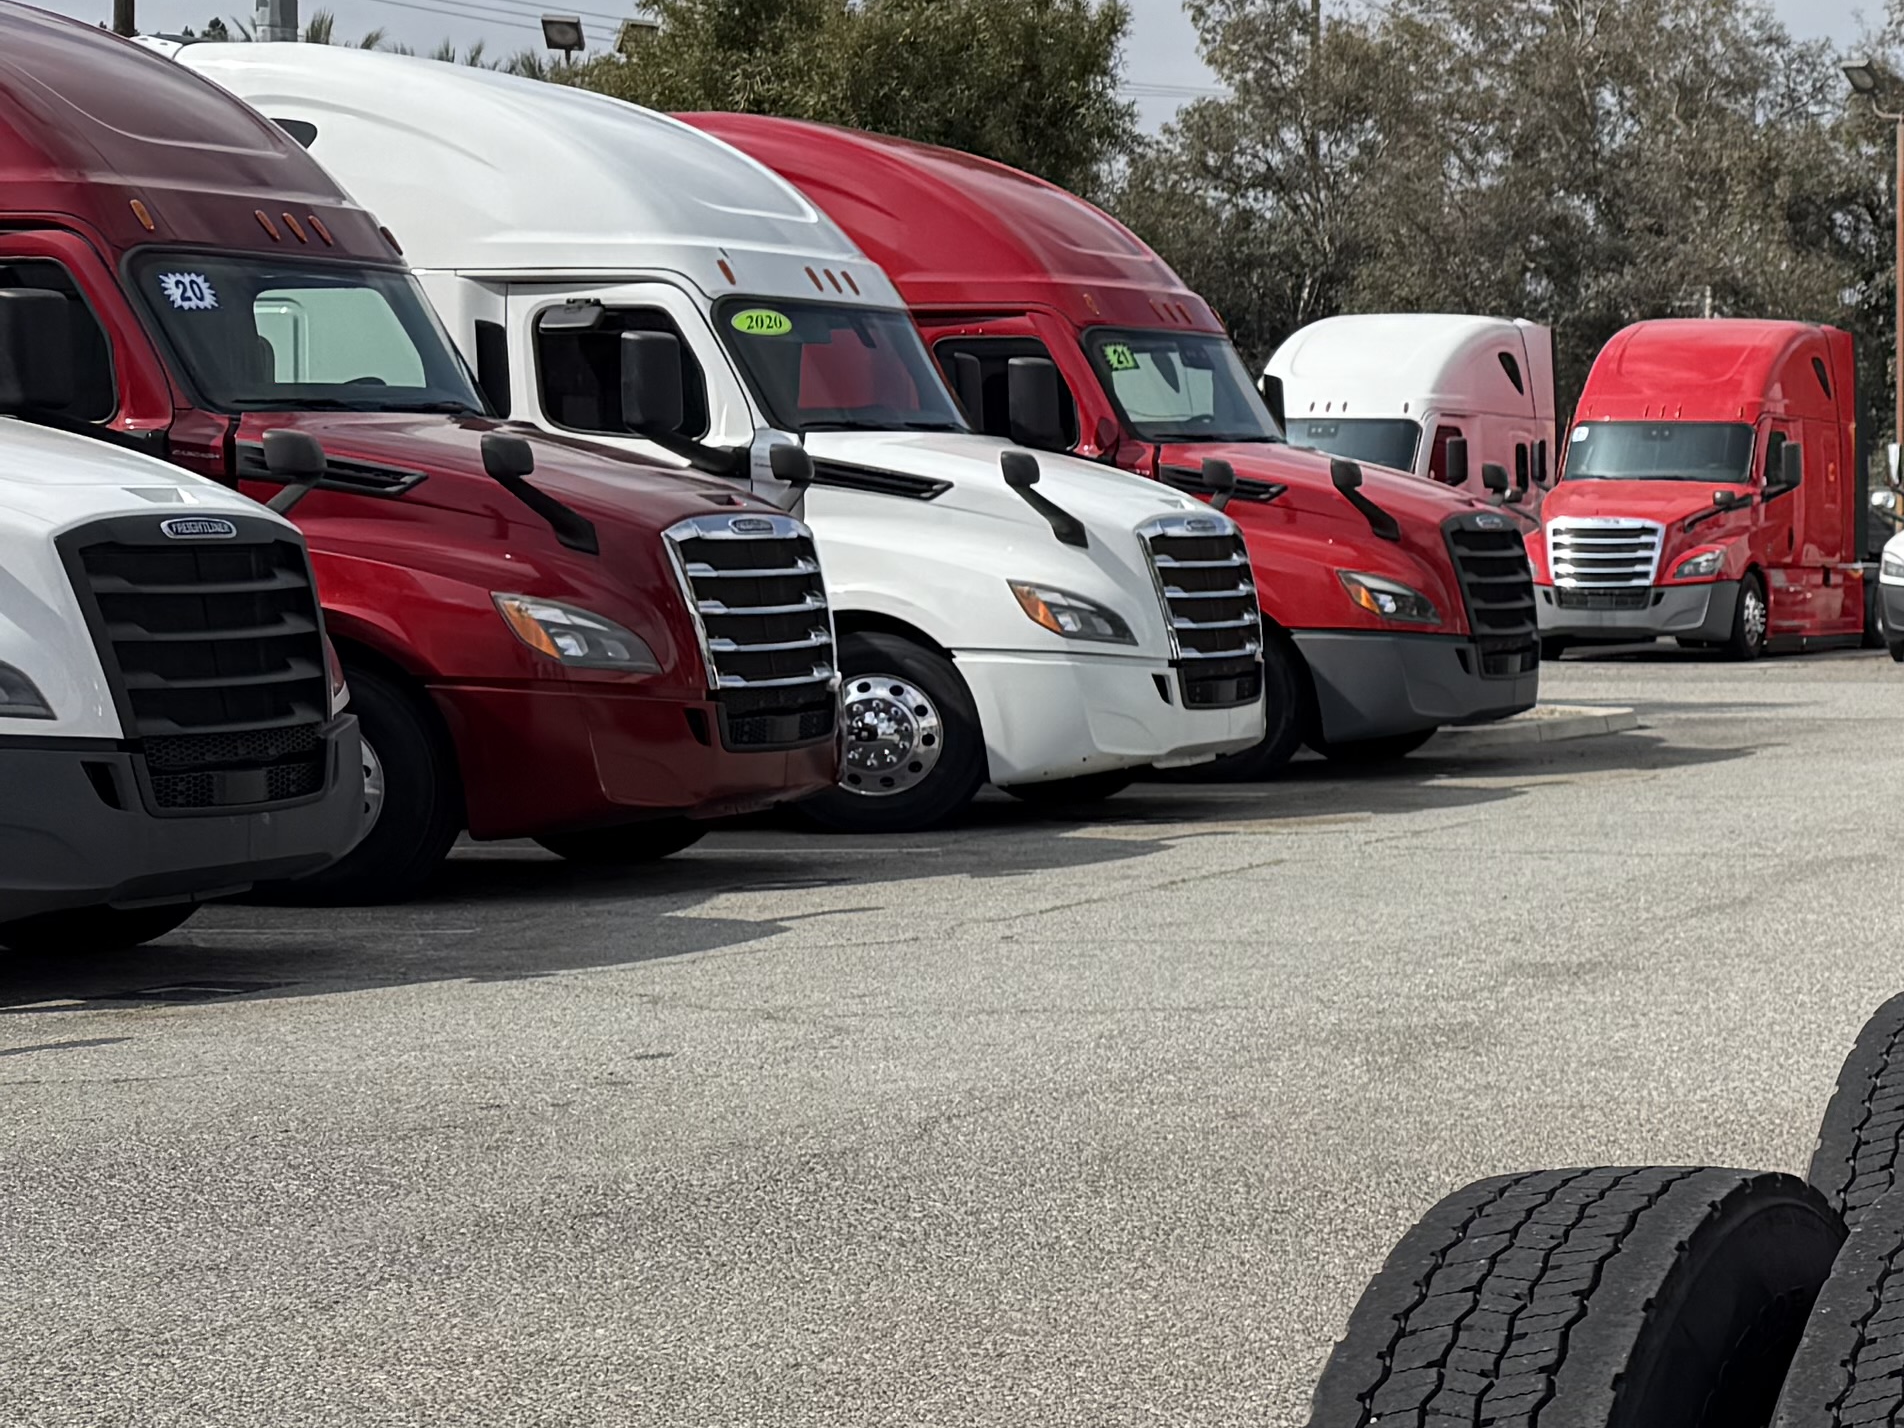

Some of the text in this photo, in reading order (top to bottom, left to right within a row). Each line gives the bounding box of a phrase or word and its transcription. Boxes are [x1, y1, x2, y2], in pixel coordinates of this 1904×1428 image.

[174, 279, 205, 302] 20
[746, 314, 782, 330] 2020
[1112, 348, 1130, 365] 21
